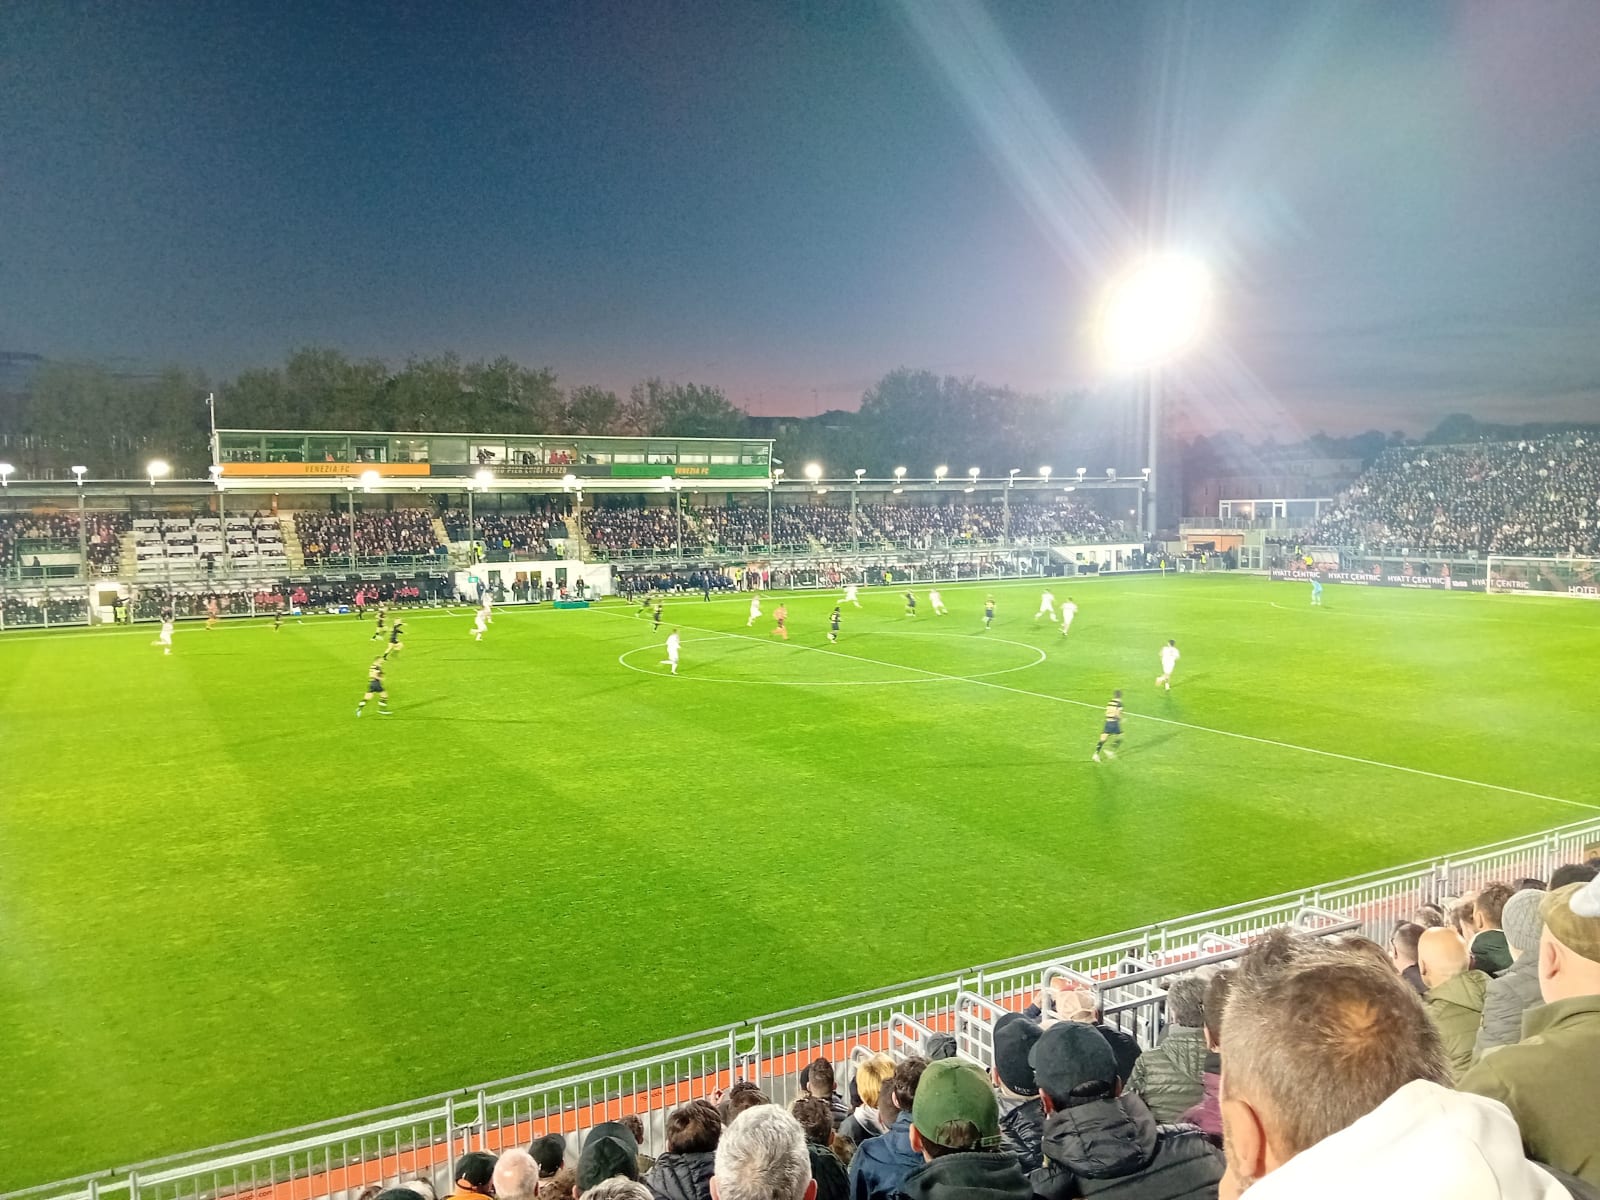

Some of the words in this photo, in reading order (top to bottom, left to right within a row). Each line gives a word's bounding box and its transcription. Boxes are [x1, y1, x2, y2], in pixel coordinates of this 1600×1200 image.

[305, 465, 338, 473] VENEZIA
[545, 466, 567, 474] PENZO
[1350, 573, 1381, 582] CENTRIC
[1412, 576, 1445, 585] CENTRIC
[1496, 579, 1530, 589] CENTRIC
